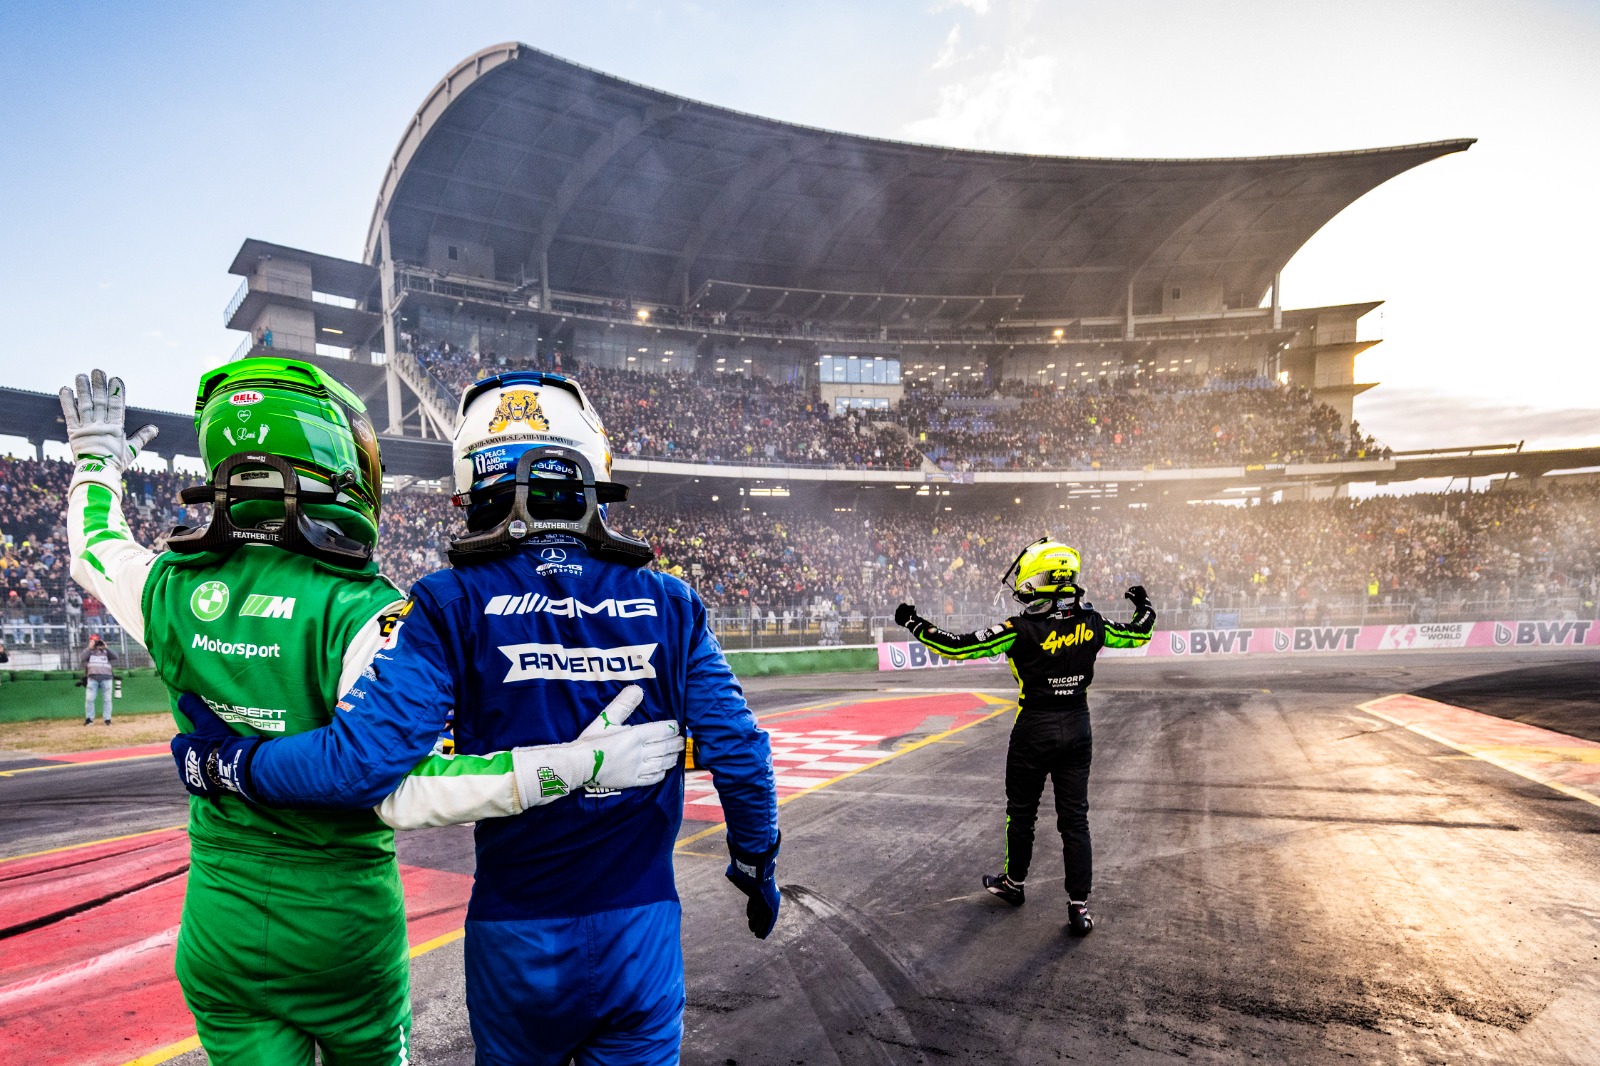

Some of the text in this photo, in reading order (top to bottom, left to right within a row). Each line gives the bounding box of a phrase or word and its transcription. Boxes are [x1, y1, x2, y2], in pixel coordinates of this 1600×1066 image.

[233, 393, 259, 402] BELL
[484, 449, 506, 458] PEACE
[486, 457, 501, 466] AND
[486, 462, 508, 472] SPORT
[200, 583, 228, 596] BMW
[1420, 624, 1463, 634] CHANGE
[1516, 621, 1591, 645] BWT
[1039, 622, 1095, 655] Grello
[1189, 630, 1253, 654] BWT
[1293, 627, 1361, 651] BWT
[1427, 631, 1462, 641] WORLD
[191, 633, 281, 659] Motorsport
[1047, 674, 1085, 685] TRICORP
[187, 750, 202, 788] OMP
